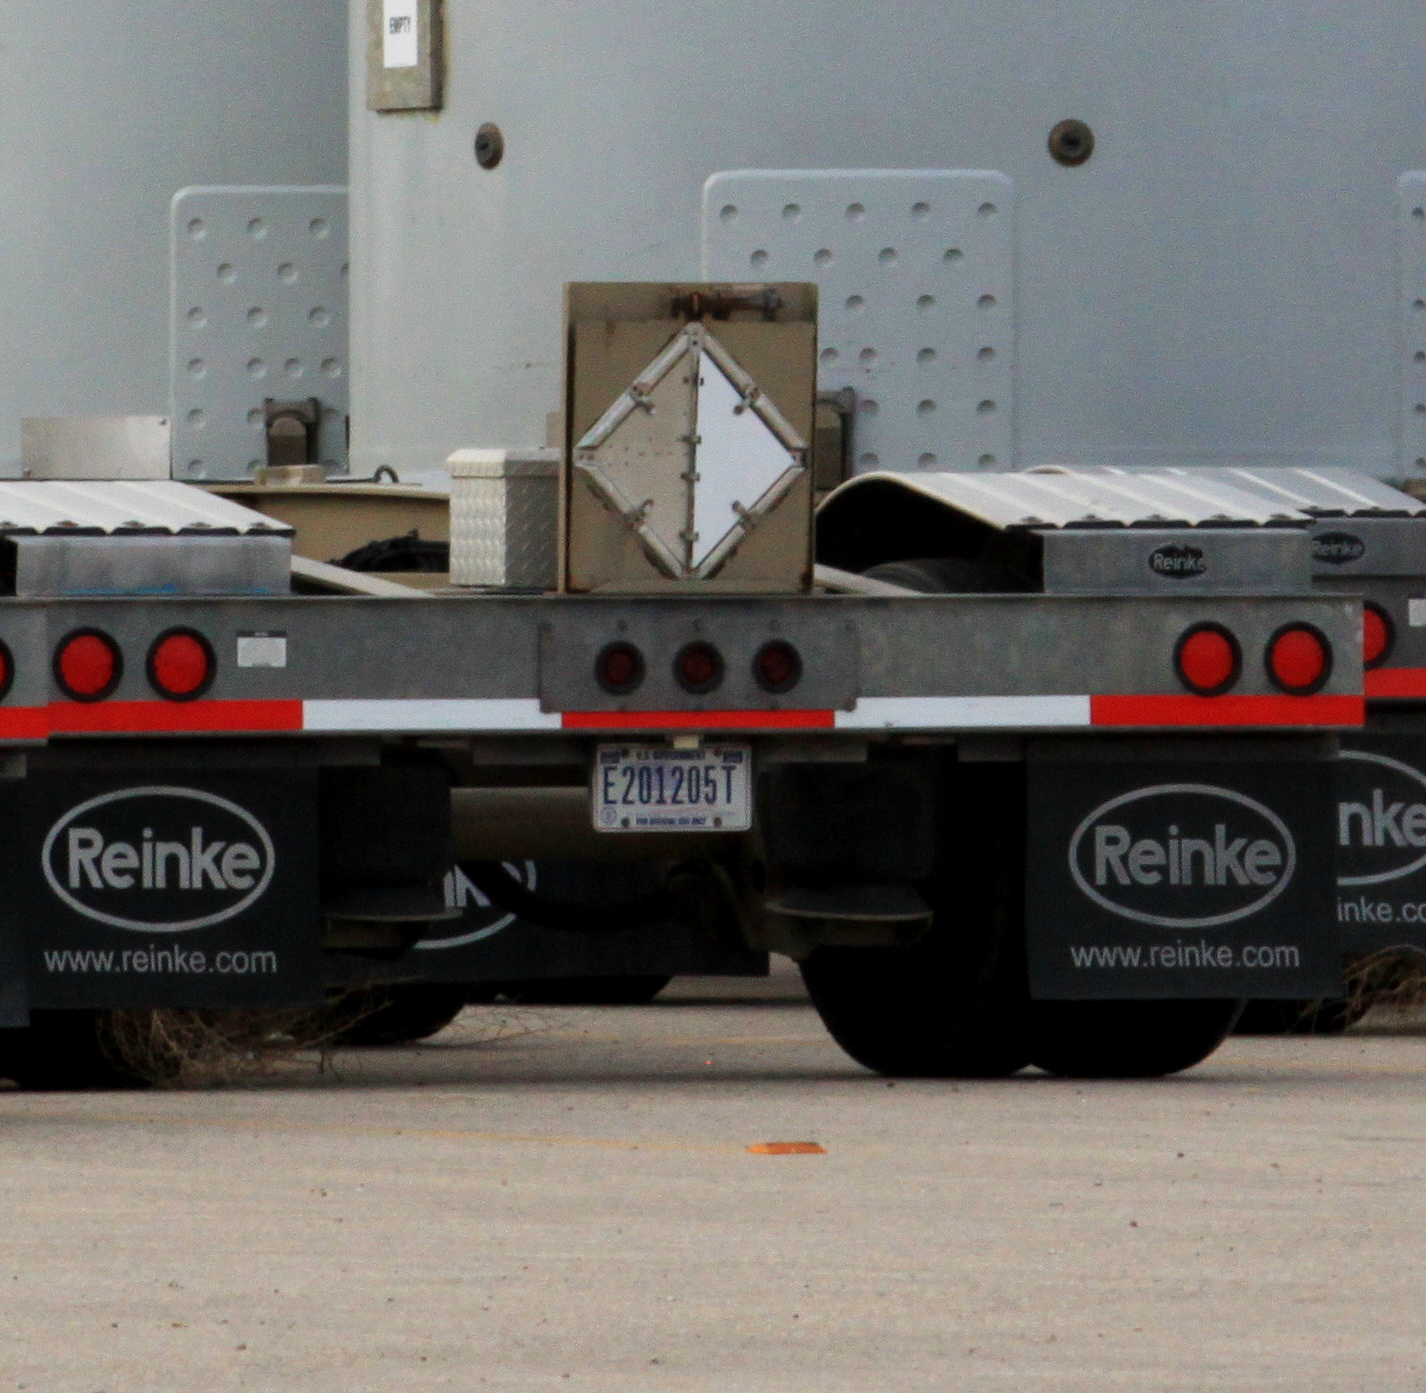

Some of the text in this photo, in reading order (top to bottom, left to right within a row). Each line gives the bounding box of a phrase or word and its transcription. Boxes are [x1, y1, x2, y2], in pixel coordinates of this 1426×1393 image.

[603, 765, 737, 805] E201205T
[68, 826, 261, 891] Reinke
[1095, 824, 1282, 887] Reinke
[44, 944, 278, 974] www.reinke.com
[1070, 938, 1301, 969] www.reinke.com
